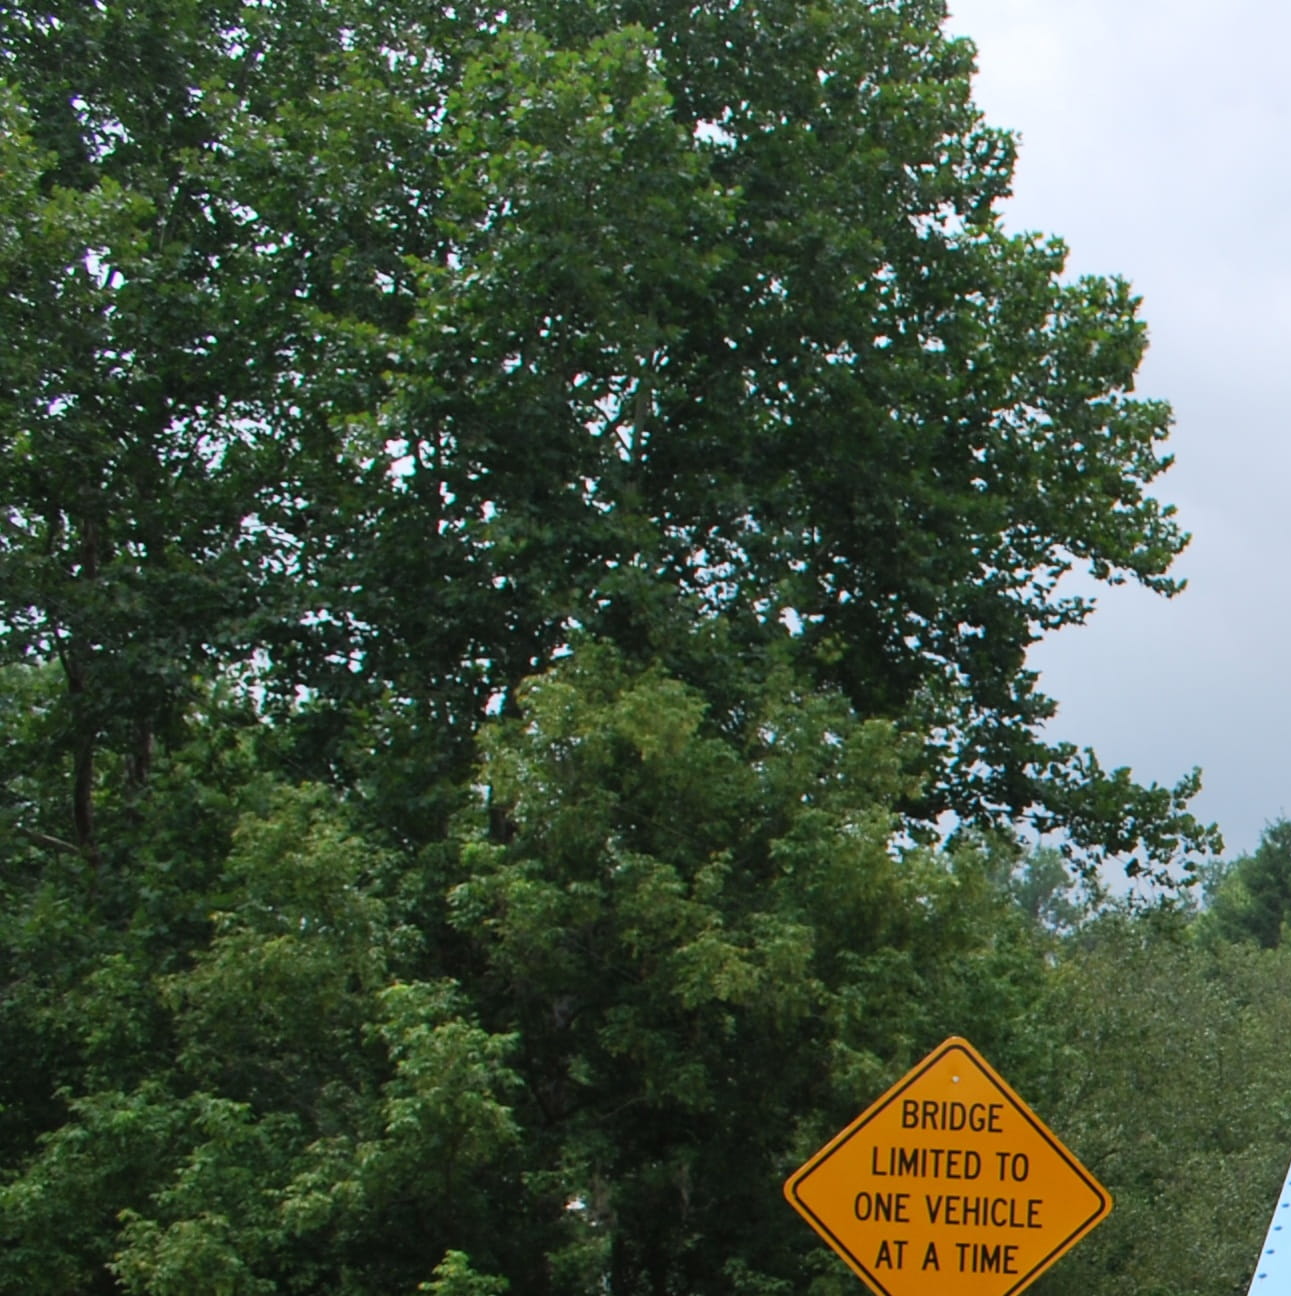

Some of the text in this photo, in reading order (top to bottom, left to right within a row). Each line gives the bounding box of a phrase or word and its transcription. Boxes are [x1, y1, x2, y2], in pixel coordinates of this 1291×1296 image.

[901, 1099, 1004, 1133] BRIDGE
[871, 1146, 1029, 1182] LIMITED TO
[854, 1192, 1043, 1229] ONE VEHICLE
[874, 1240, 1019, 1275] AT A TIME
